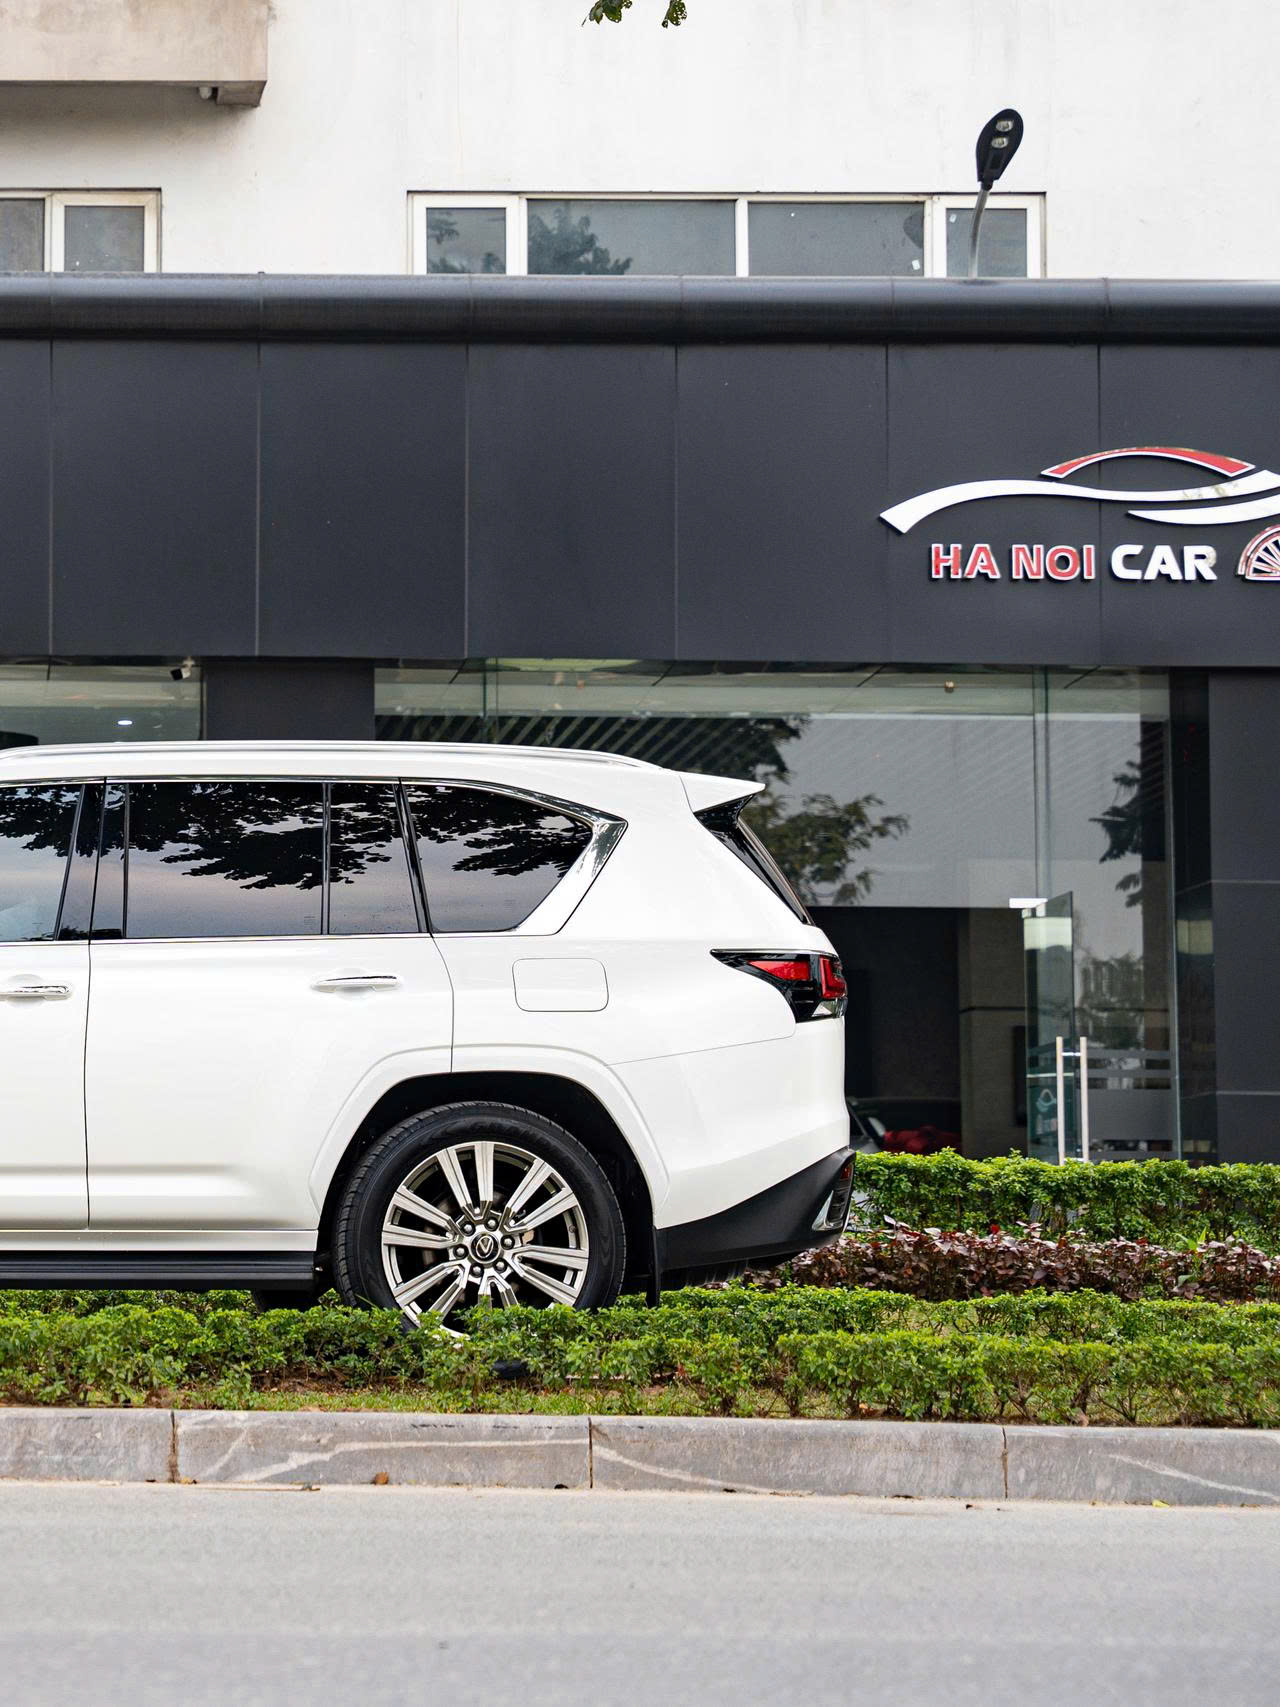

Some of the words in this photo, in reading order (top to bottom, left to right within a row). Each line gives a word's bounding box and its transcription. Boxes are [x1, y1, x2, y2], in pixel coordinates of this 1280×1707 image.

[931, 542, 1001, 580] HA
[1011, 543, 1096, 581] NOI
[1110, 543, 1218, 581] CAR
